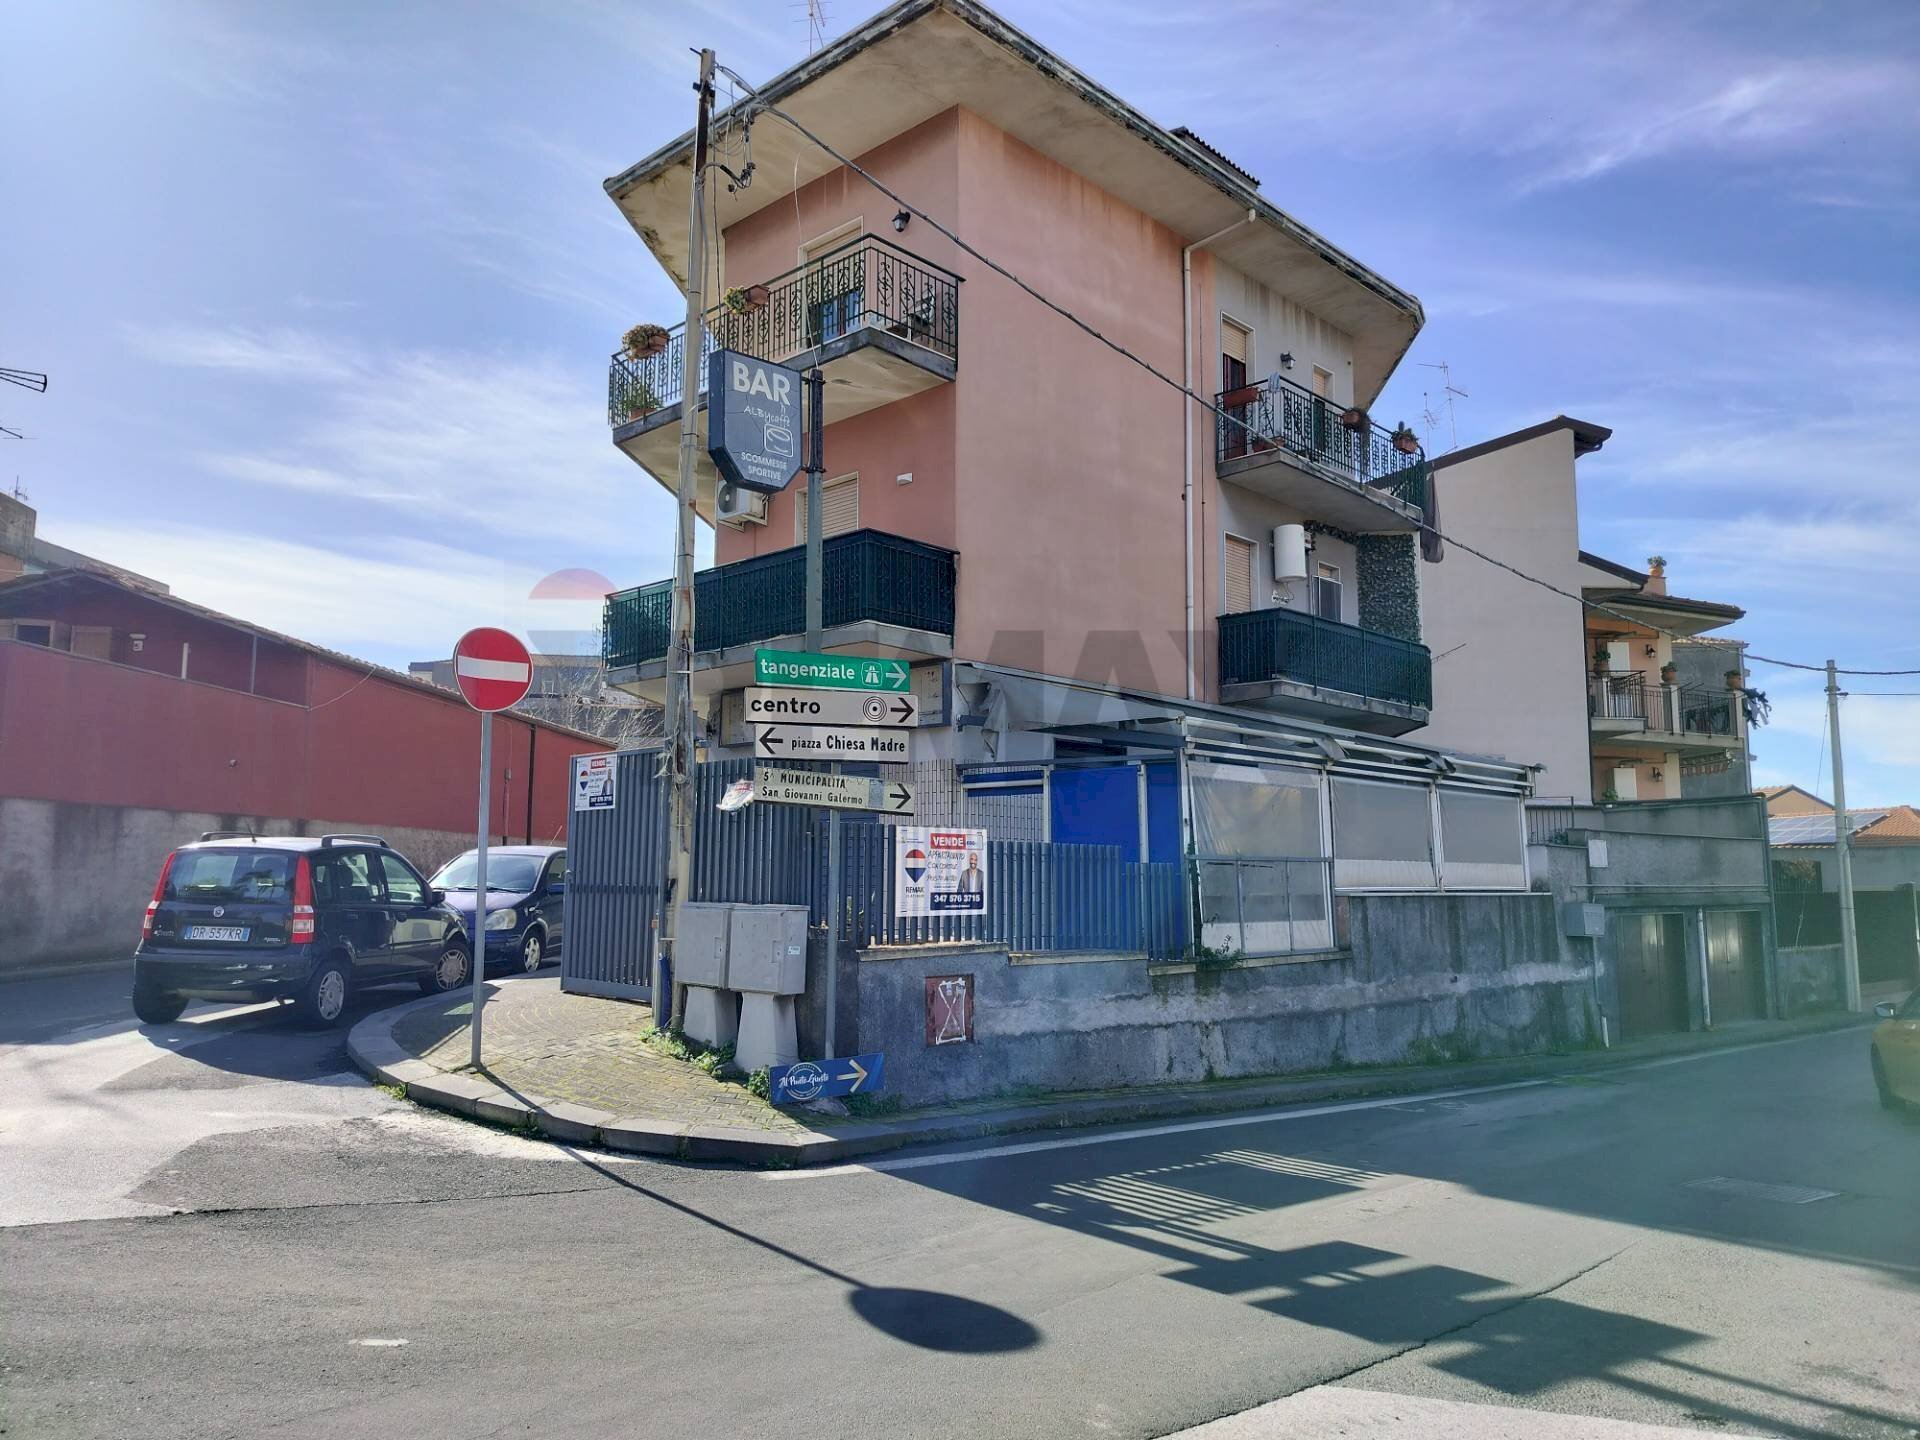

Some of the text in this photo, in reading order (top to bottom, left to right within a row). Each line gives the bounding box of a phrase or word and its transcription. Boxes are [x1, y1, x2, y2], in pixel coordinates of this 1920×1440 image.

[732, 361, 791, 405] BAR
[741, 451, 787, 471] SCOMMESSE
[747, 465, 782, 481] SPORTIVE
[760, 658, 855, 680] tangenziale
[750, 697, 821, 714] centro
[791, 735, 905, 752] piazza Chiesa Madre
[762, 785, 778, 797] San
[784, 787, 822, 801] Giovanni
[827, 792, 863, 805] Galermo
[933, 836, 964, 847] VENDE
[934, 894, 948, 903] 347
[963, 894, 981, 903] 3715
[192, 927, 206, 939] DR
